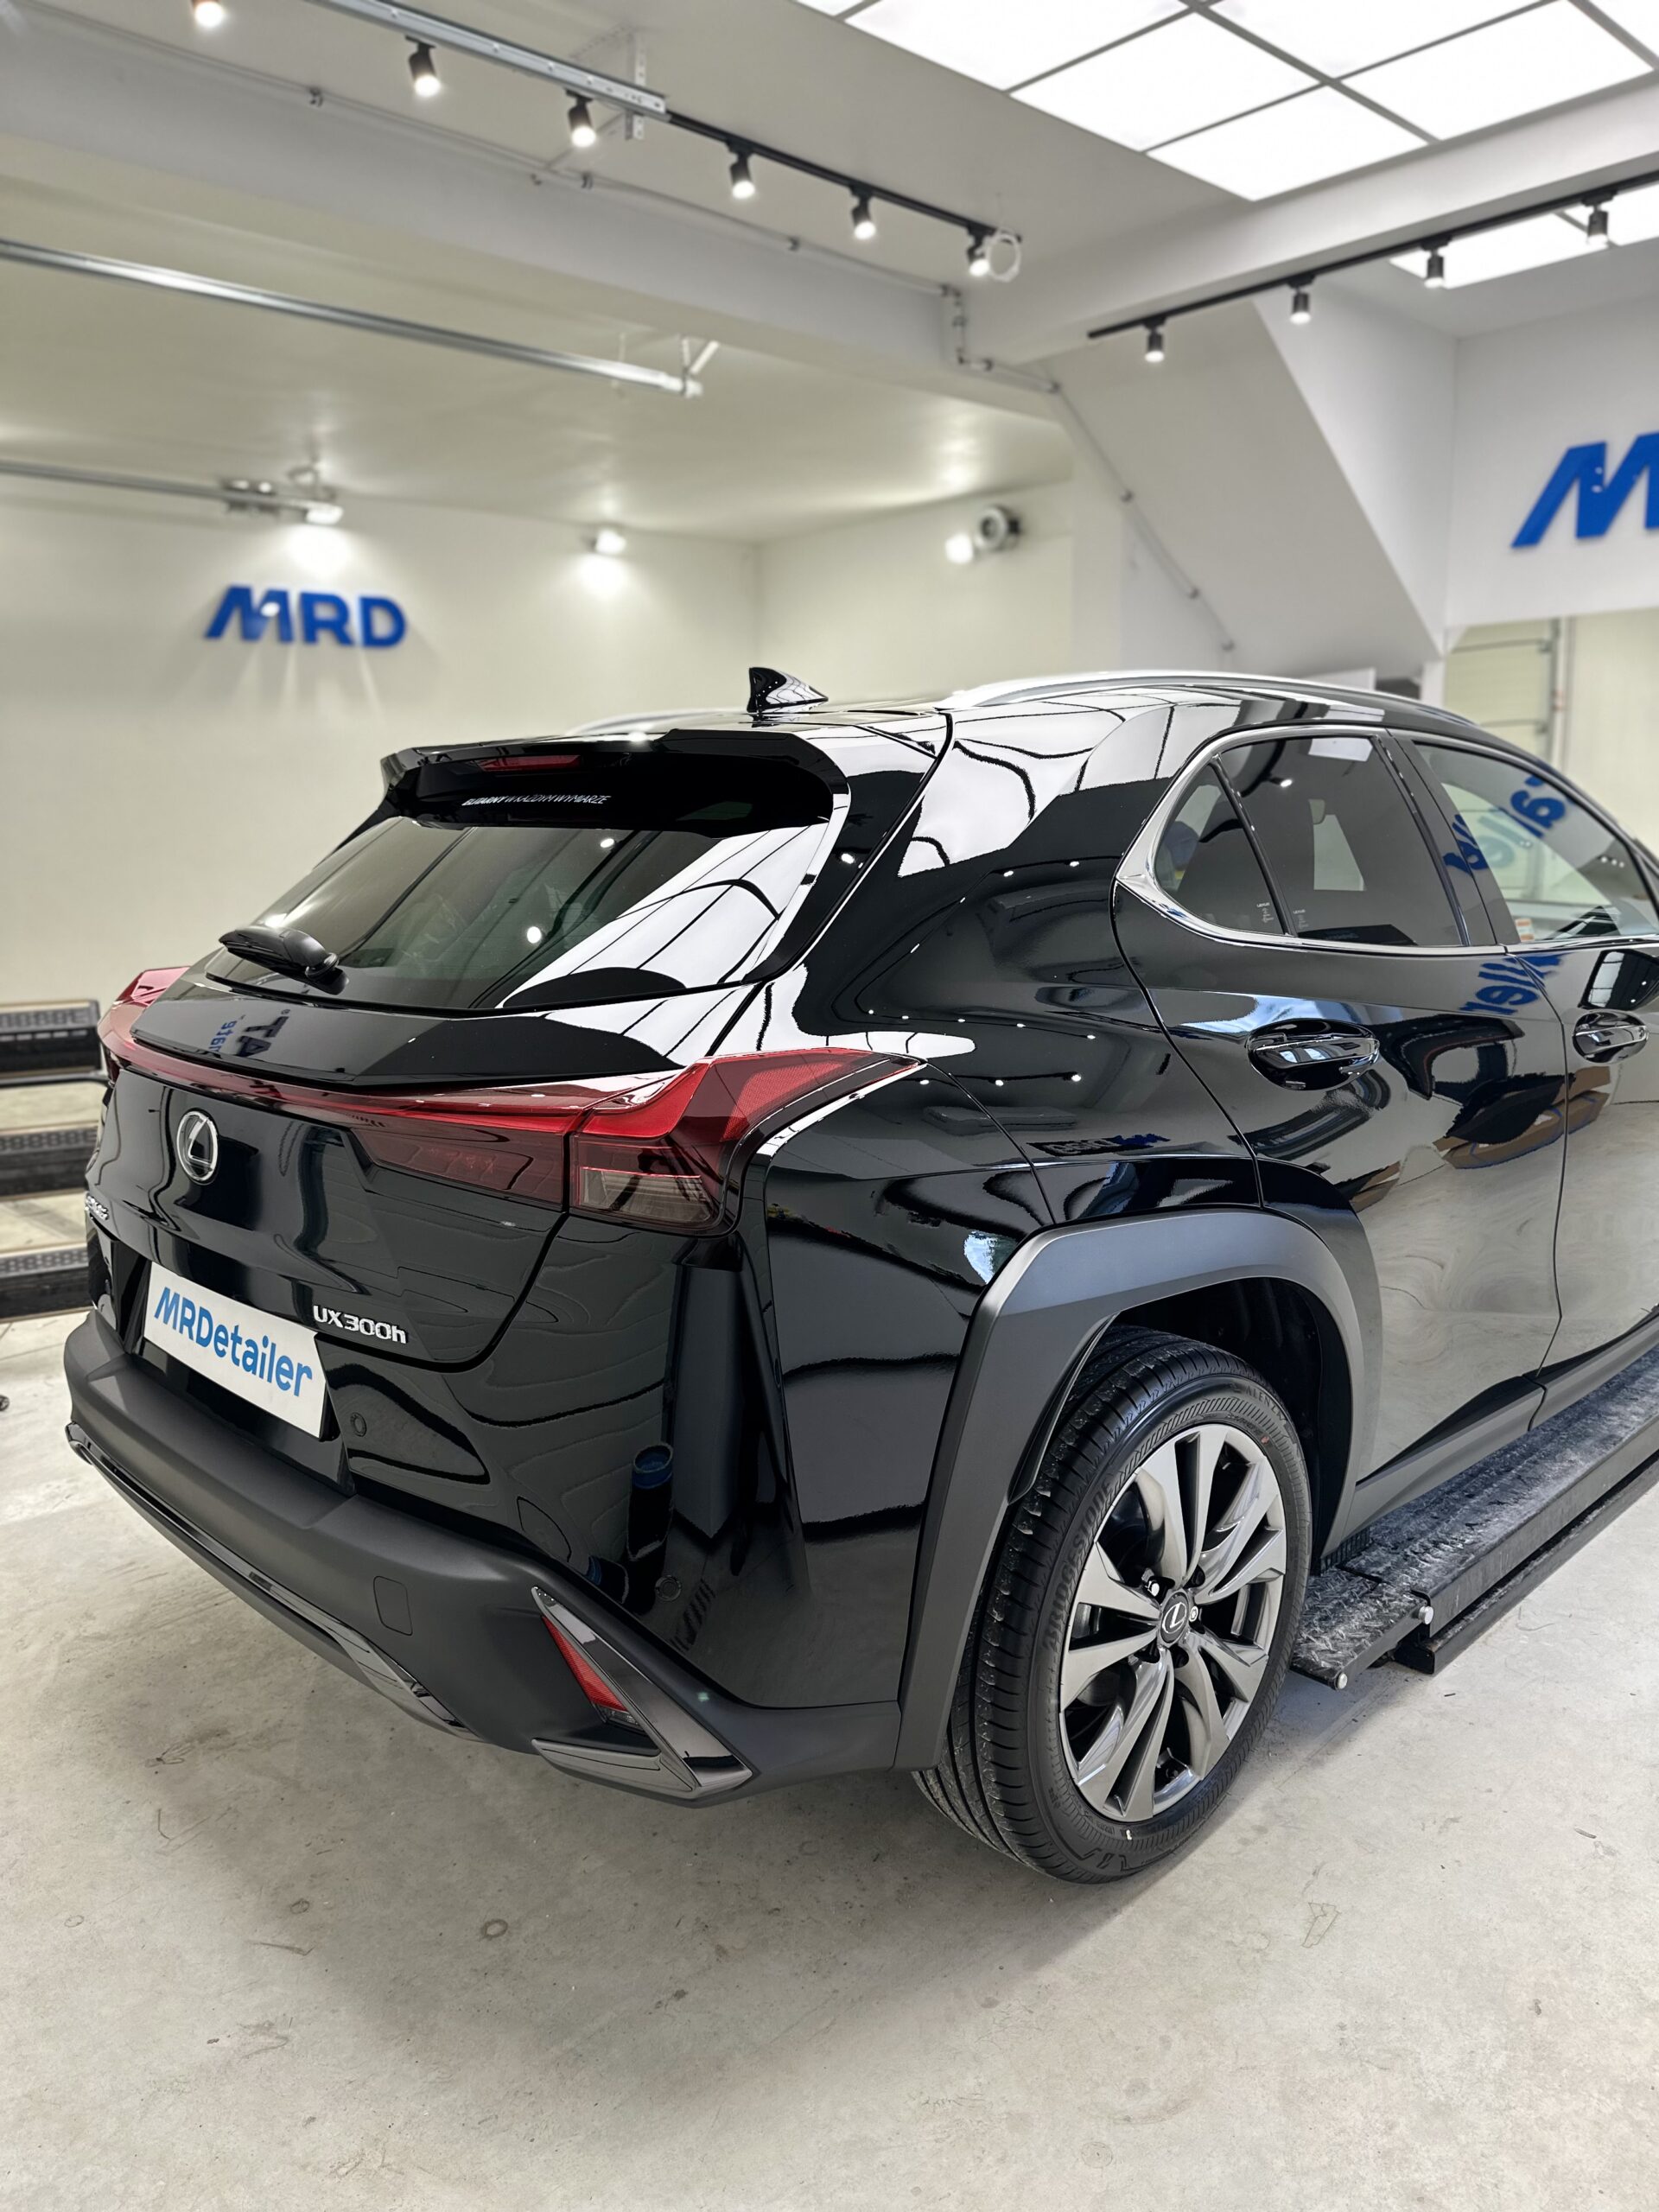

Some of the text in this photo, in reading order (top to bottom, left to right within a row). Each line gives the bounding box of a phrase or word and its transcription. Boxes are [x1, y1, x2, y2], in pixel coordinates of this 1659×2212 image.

[204, 585, 407, 648] MRD
[154, 1287, 313, 1397] MRDetailer
[1042, 1477, 1114, 1649] BRIDGESTONE
